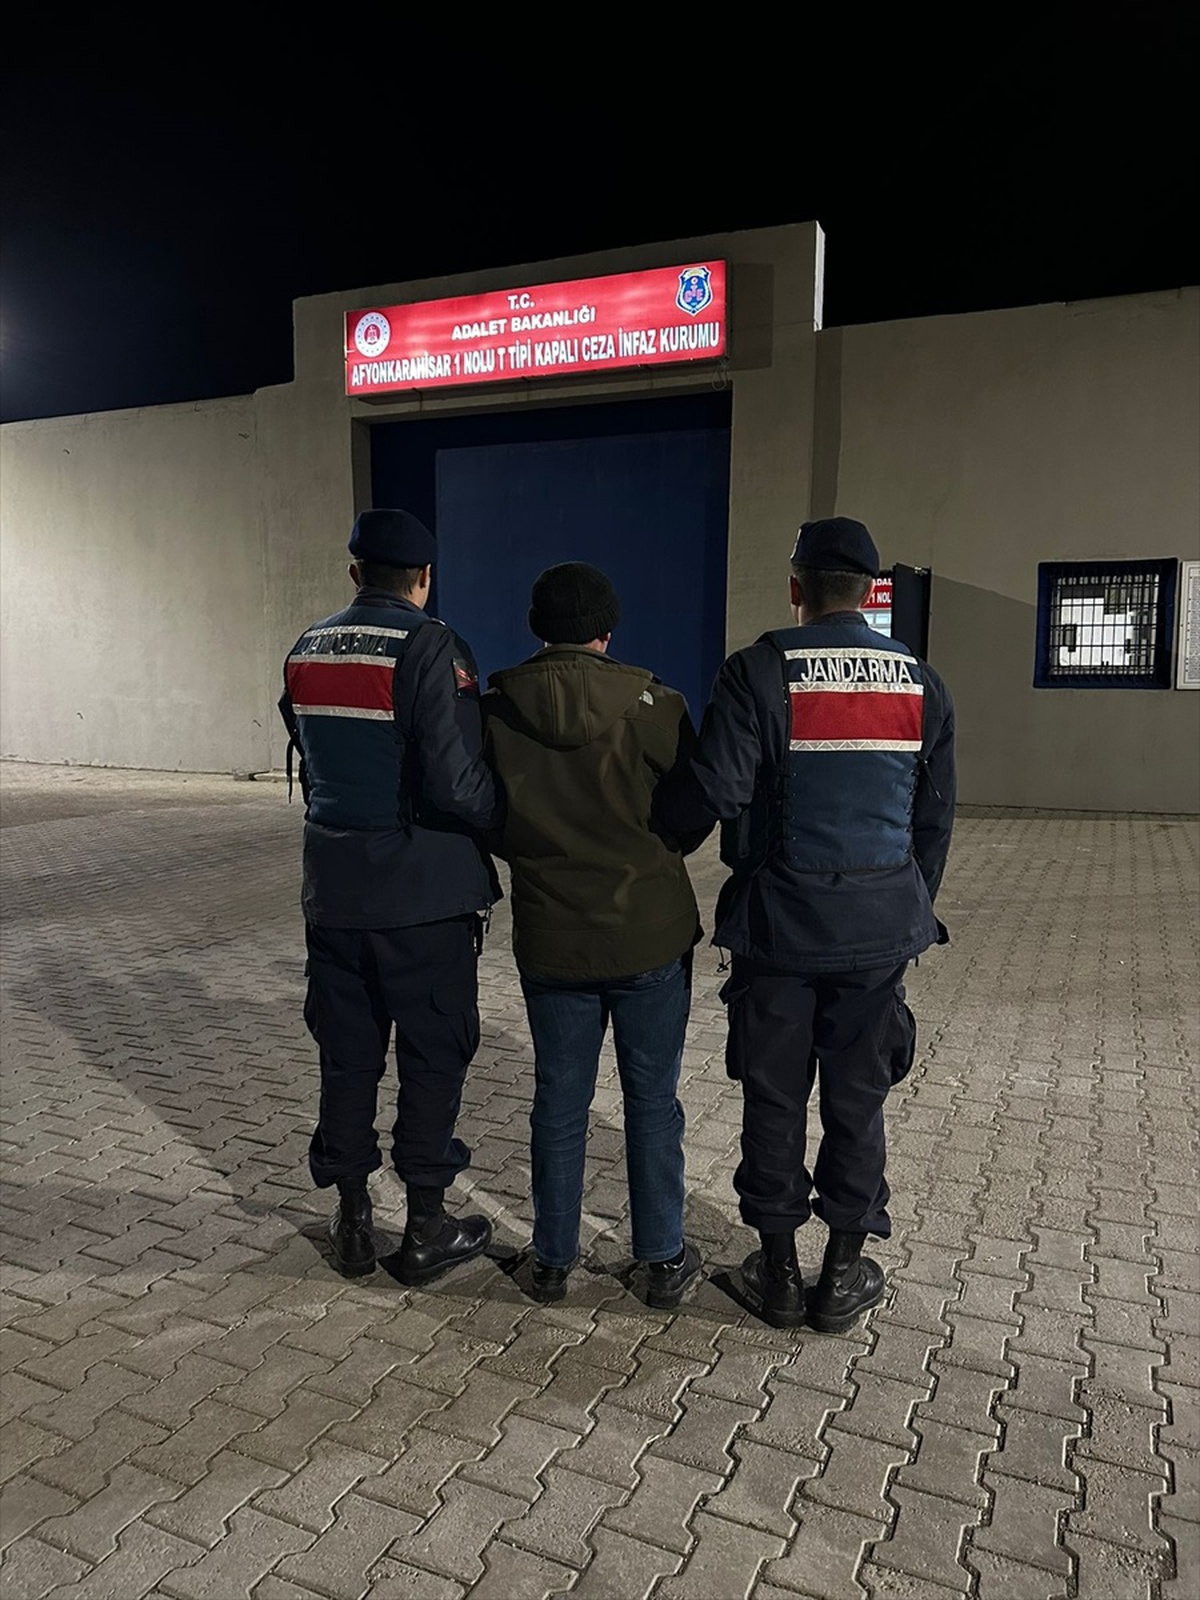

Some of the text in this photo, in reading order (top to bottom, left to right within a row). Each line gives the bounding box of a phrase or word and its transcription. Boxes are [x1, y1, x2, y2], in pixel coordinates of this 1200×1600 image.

[507, 293, 535, 310] T.C.
[451, 304, 596, 341] ADALET BAKANLIĞI
[351, 321, 719, 386] AFYONKARAHİSAR 1 NOLU T TİPİ KAPALI CEZA İNFAZ KURUMU
[801, 658, 913, 684] JANDARMA
